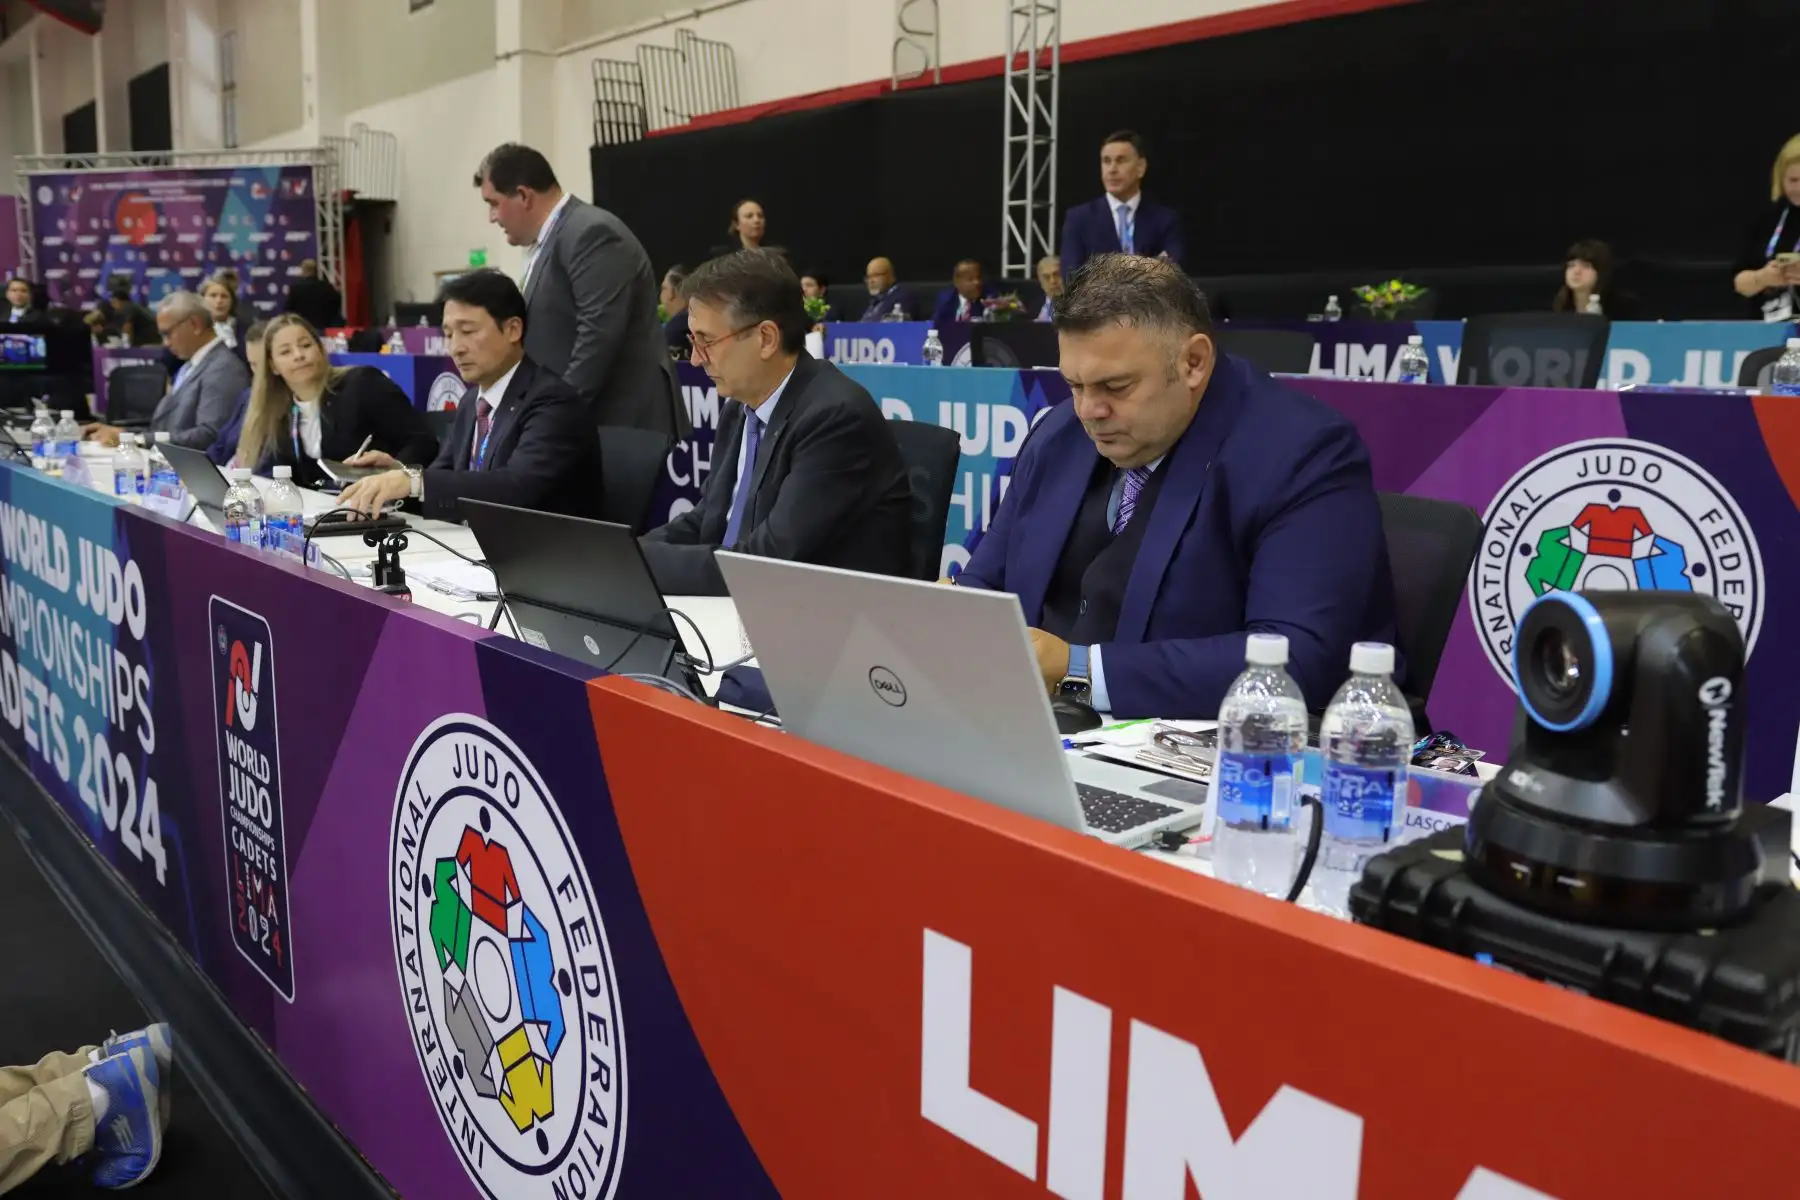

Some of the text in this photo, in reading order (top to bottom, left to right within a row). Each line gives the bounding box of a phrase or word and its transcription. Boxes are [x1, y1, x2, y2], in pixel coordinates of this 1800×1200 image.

[425, 336, 452, 356] LIM
[830, 338, 896, 364] JUDO
[1668, 350, 1772, 389] JU
[681, 386, 730, 430] IM
[939, 401, 1053, 458] JUD
[0, 501, 147, 640] WORLD JUDO
[1484, 455, 1745, 655] RNATIONAL JUDO FEDER
[0, 574, 155, 754] MPIONSHIPS
[0, 648, 167, 887] DETS 2024
[225, 730, 270, 785] WORLD
[229, 764, 272, 829] JUDO
[230, 805, 275, 851] CHAMPIONSHIPS
[231, 826, 277, 882] CADETS
[399, 743, 611, 1200] INTERNATIONAL JUDO FEDERATION
[920, 926, 1564, 1200] LIM
